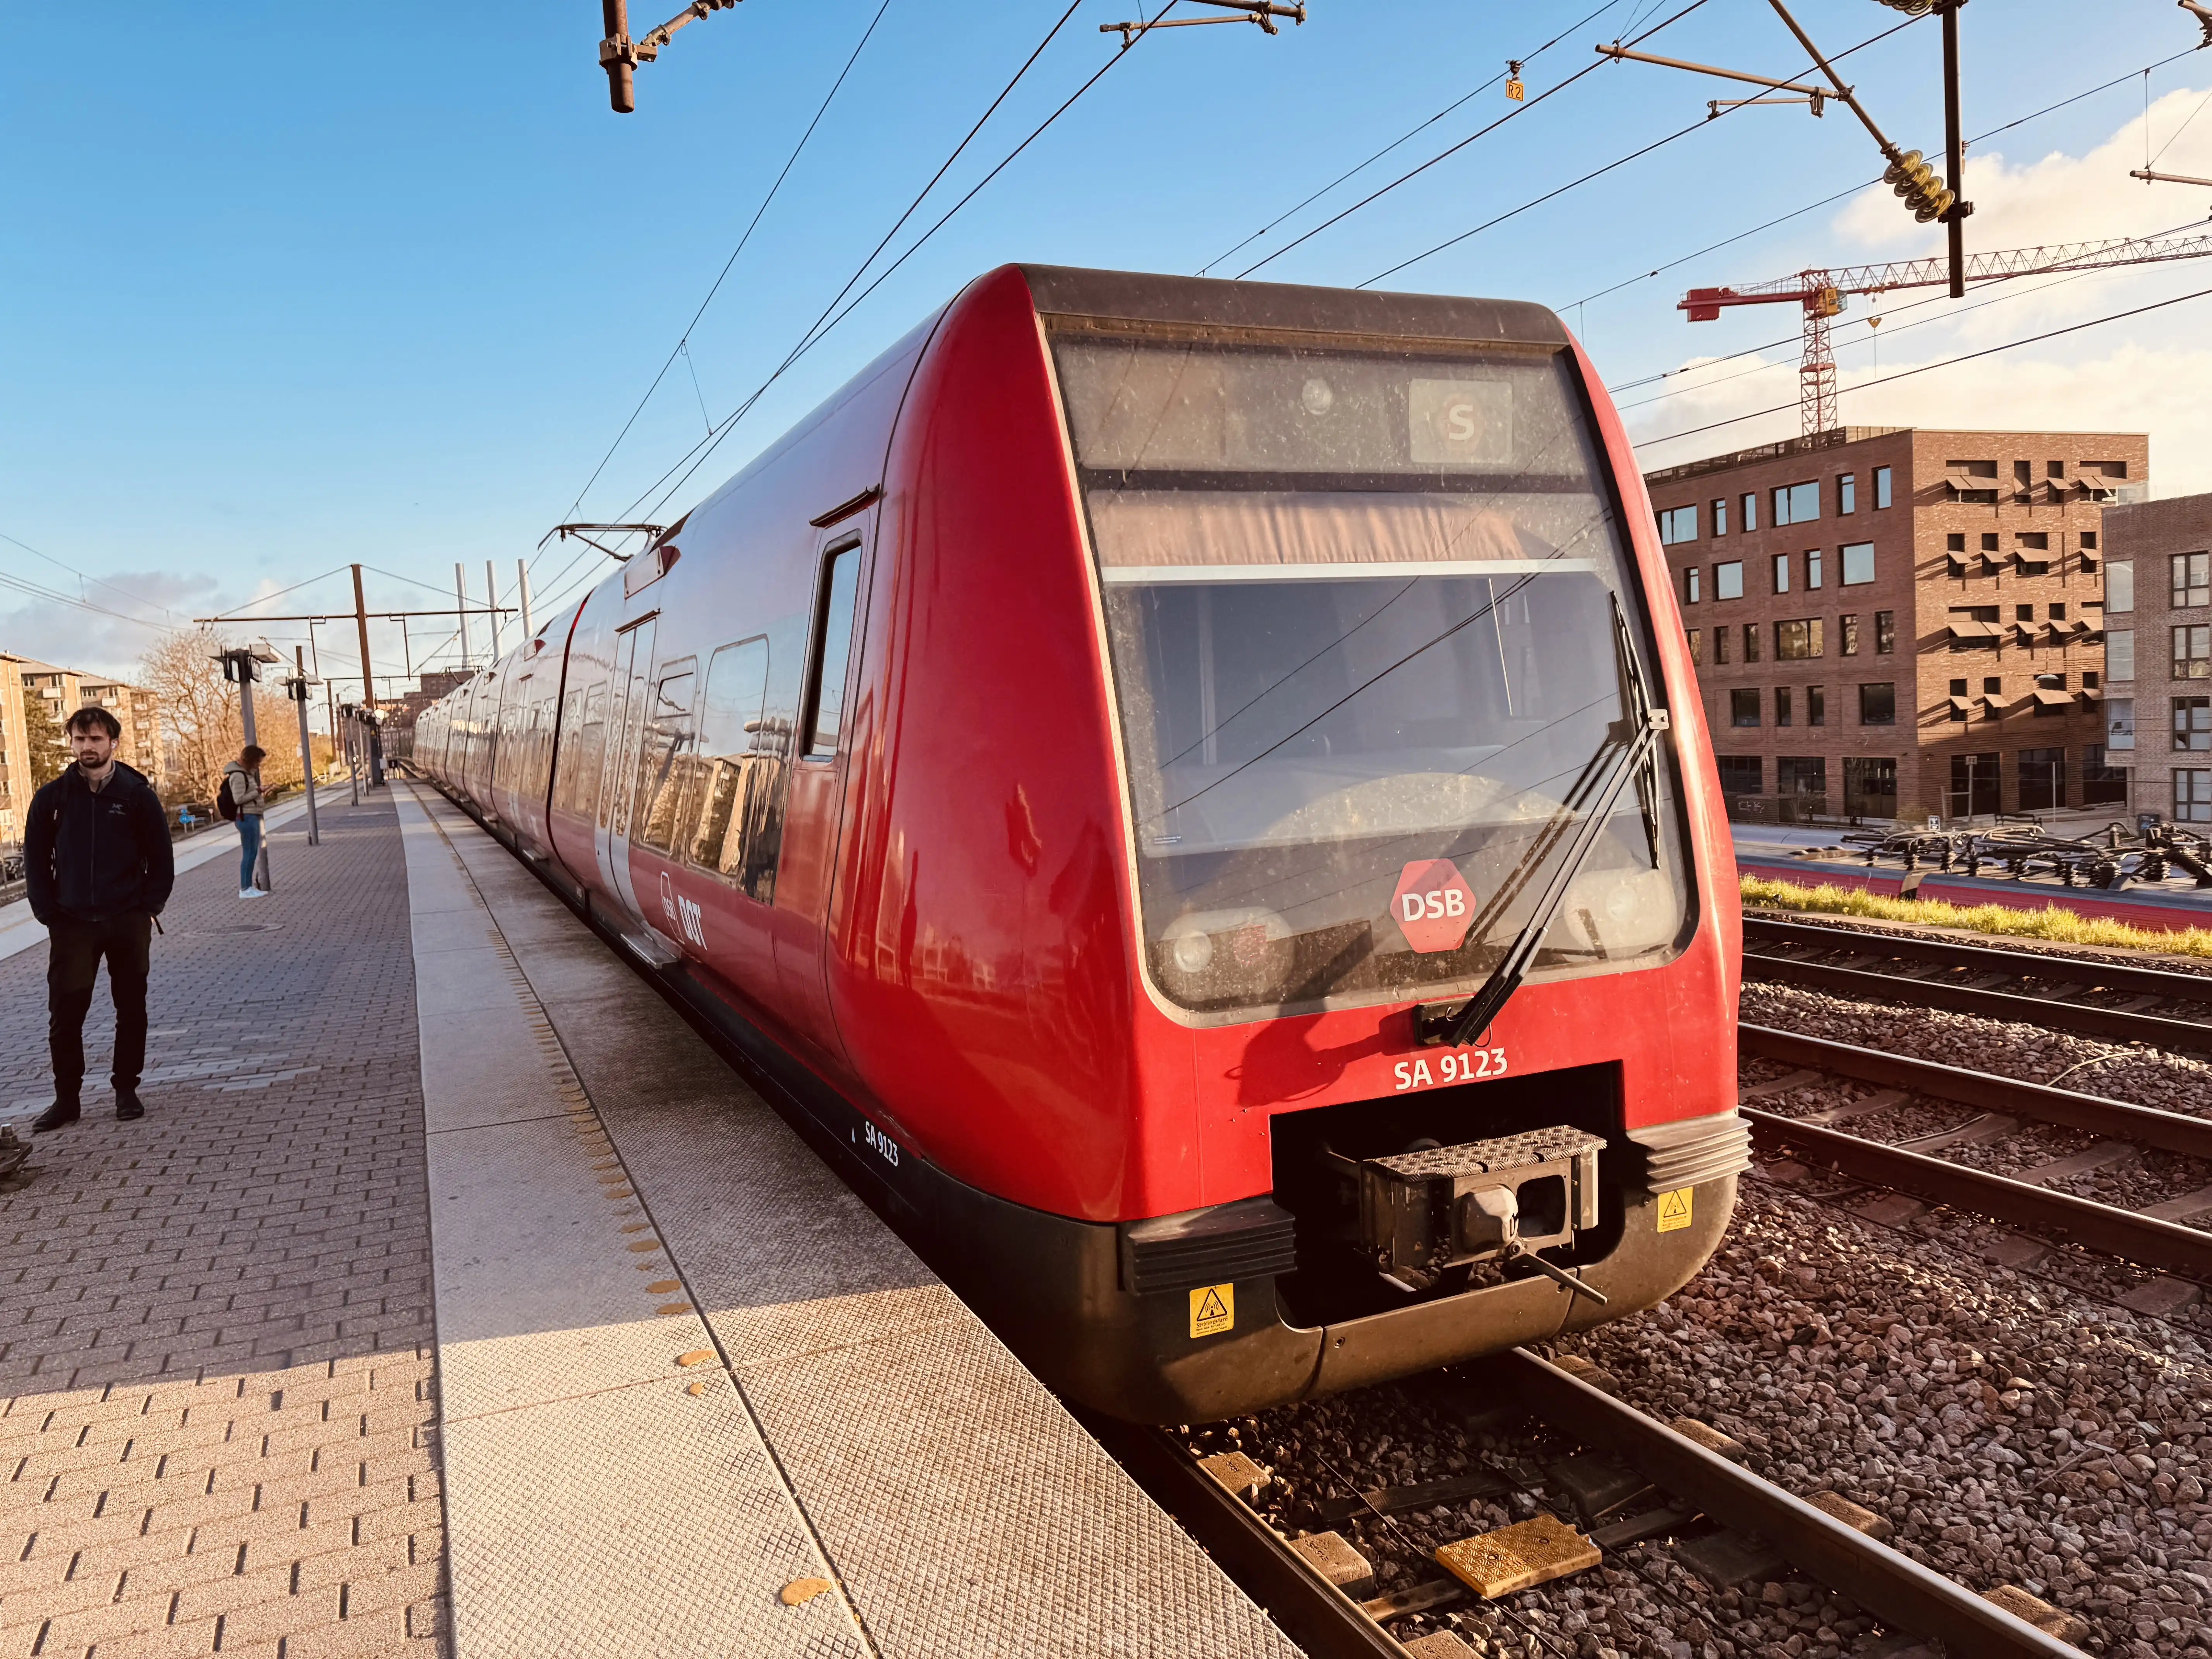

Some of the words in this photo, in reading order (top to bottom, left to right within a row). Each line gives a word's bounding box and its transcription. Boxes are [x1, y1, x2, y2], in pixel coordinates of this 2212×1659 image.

[1448, 404, 1475, 440] S
[678, 895, 707, 950] DOT
[1401, 889, 1465, 922] DSB
[1394, 1059, 1434, 1090] SA
[1440, 1047, 1508, 1083] 9123
[865, 1121, 877, 1149] SA
[878, 1131, 898, 1167] 9123
